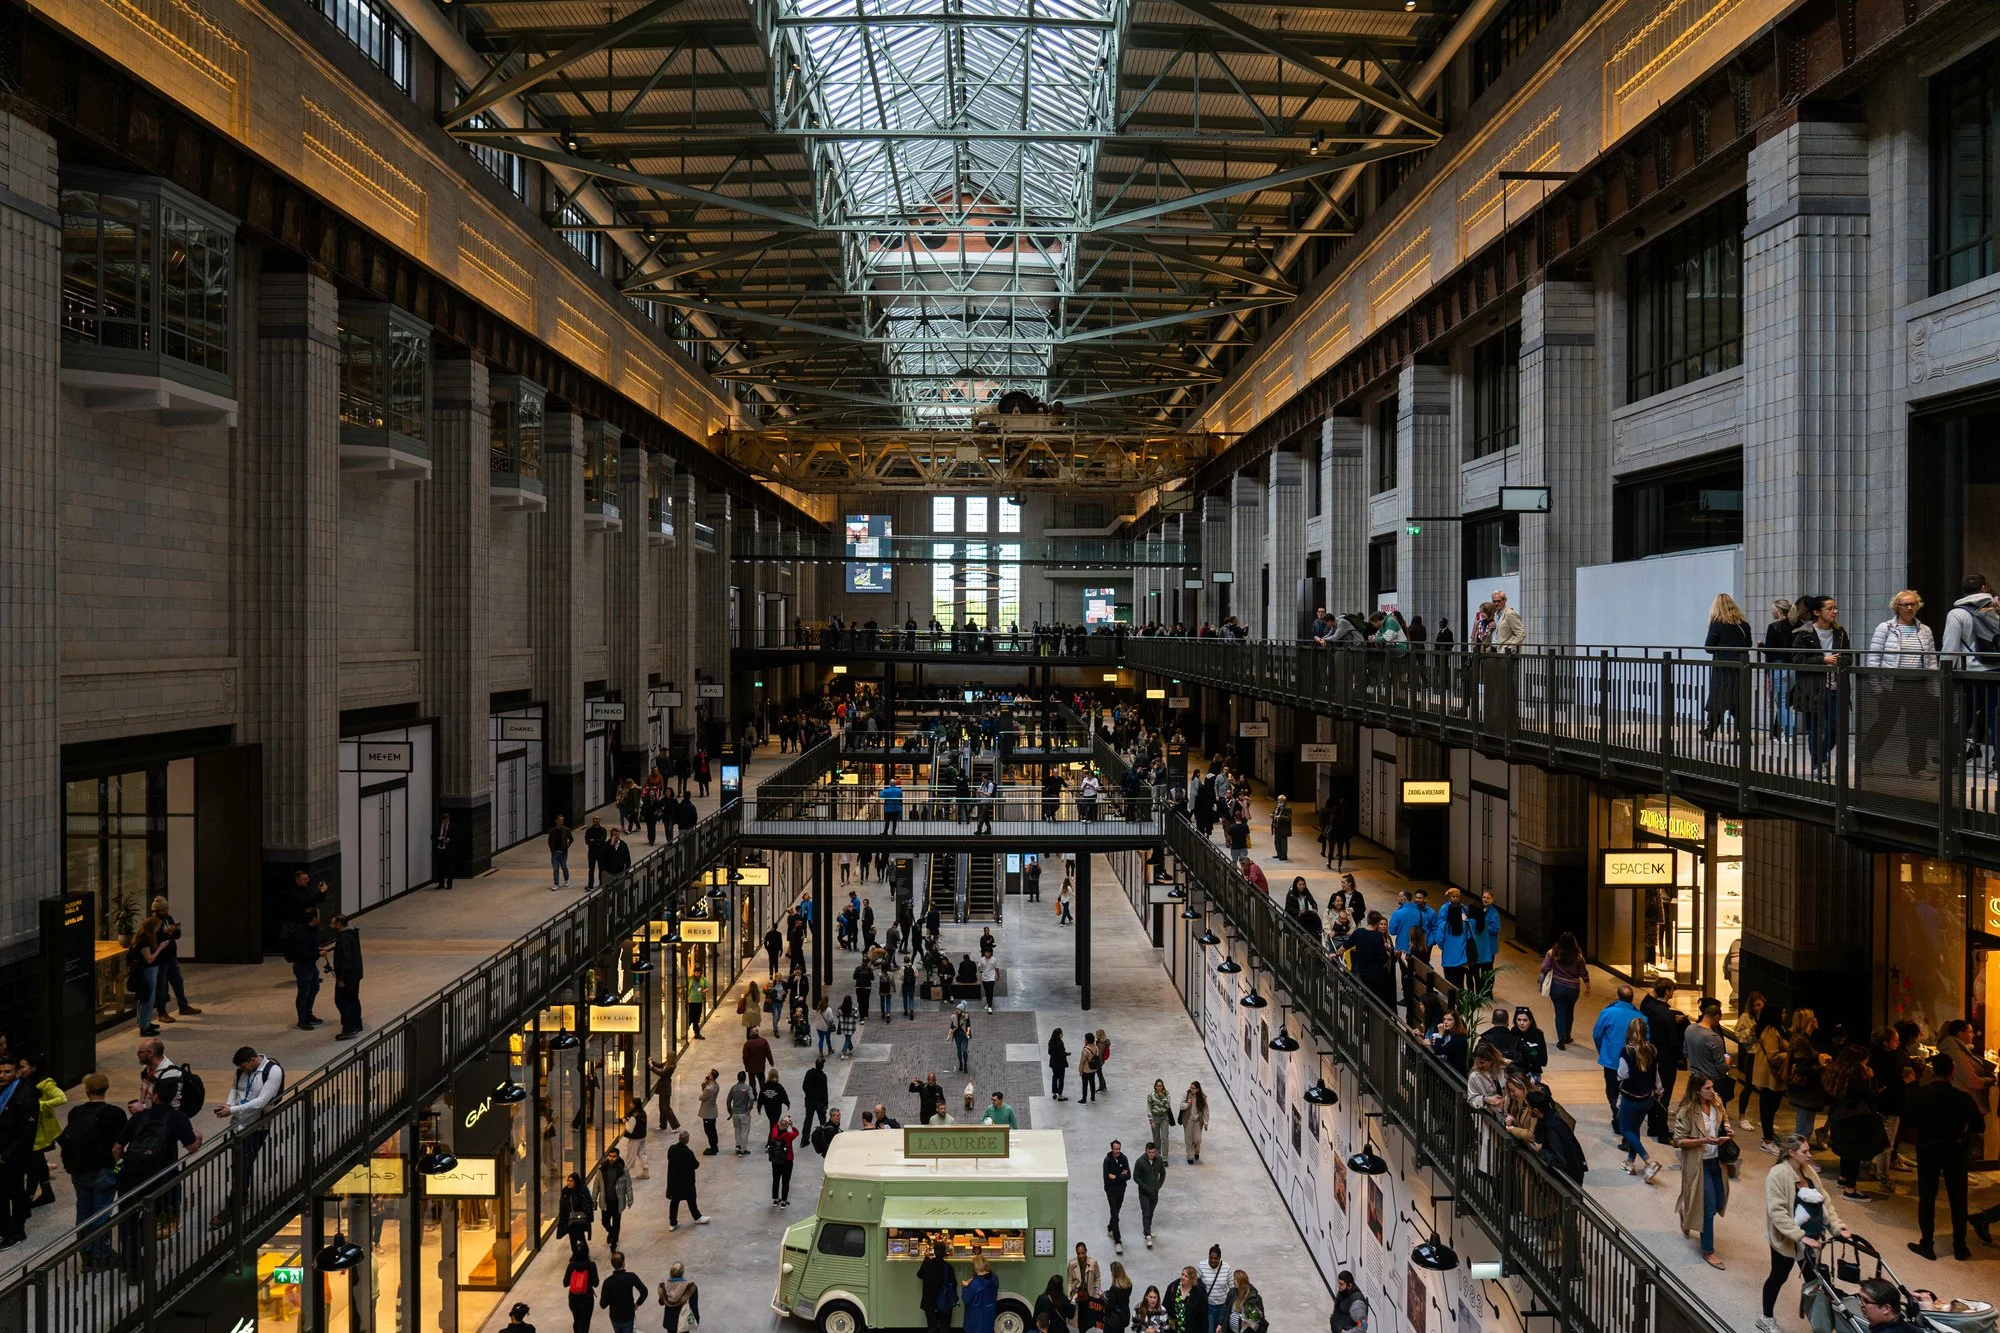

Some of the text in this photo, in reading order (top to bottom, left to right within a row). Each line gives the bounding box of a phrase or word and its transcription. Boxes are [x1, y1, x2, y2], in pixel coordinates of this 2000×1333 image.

[369, 753, 401, 761] ME+EM
[917, 1135, 998, 1150] LADURÉE
[433, 1173, 488, 1181] GANT
[925, 1207, 988, 1216] Macaron
